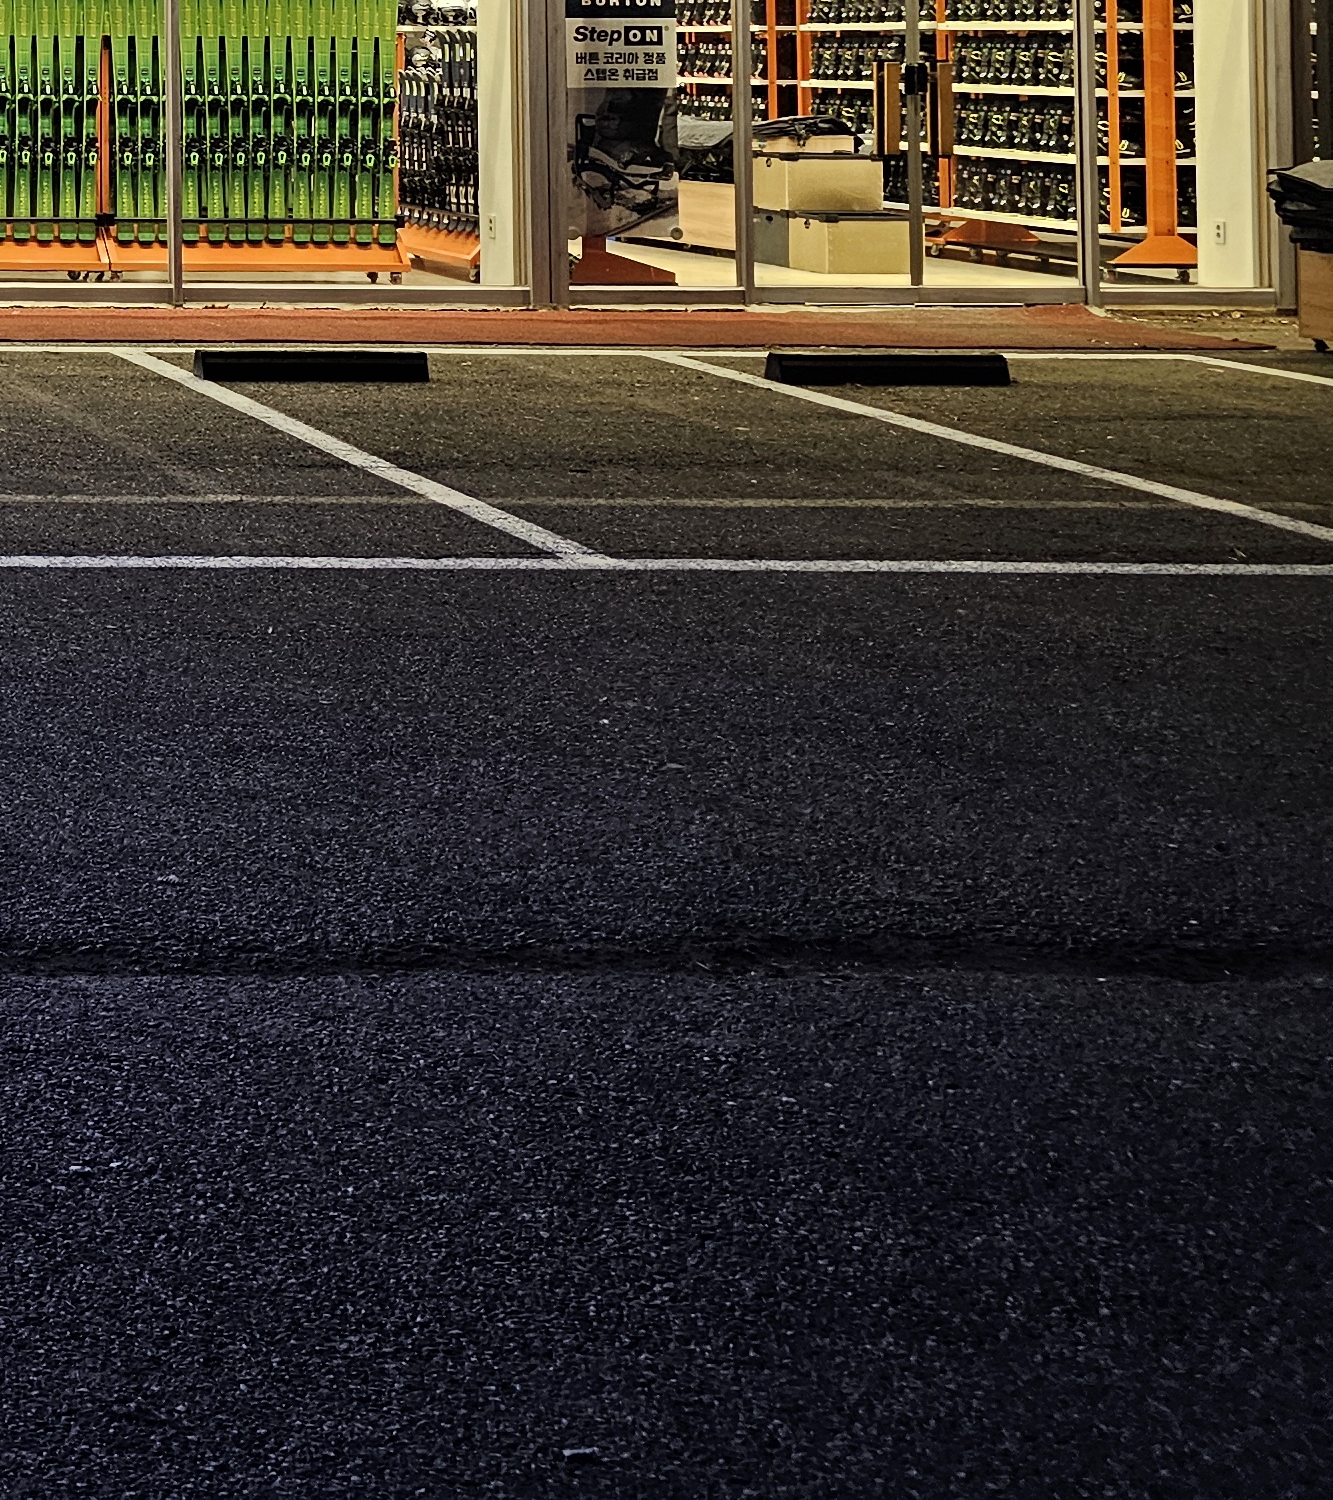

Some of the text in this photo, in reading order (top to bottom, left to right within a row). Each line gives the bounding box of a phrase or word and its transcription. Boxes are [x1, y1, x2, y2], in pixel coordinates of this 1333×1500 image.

[573, 25, 658, 47] Step ON
[603, 52, 639, 65] 코리아
[622, 68, 659, 81] 취급점
